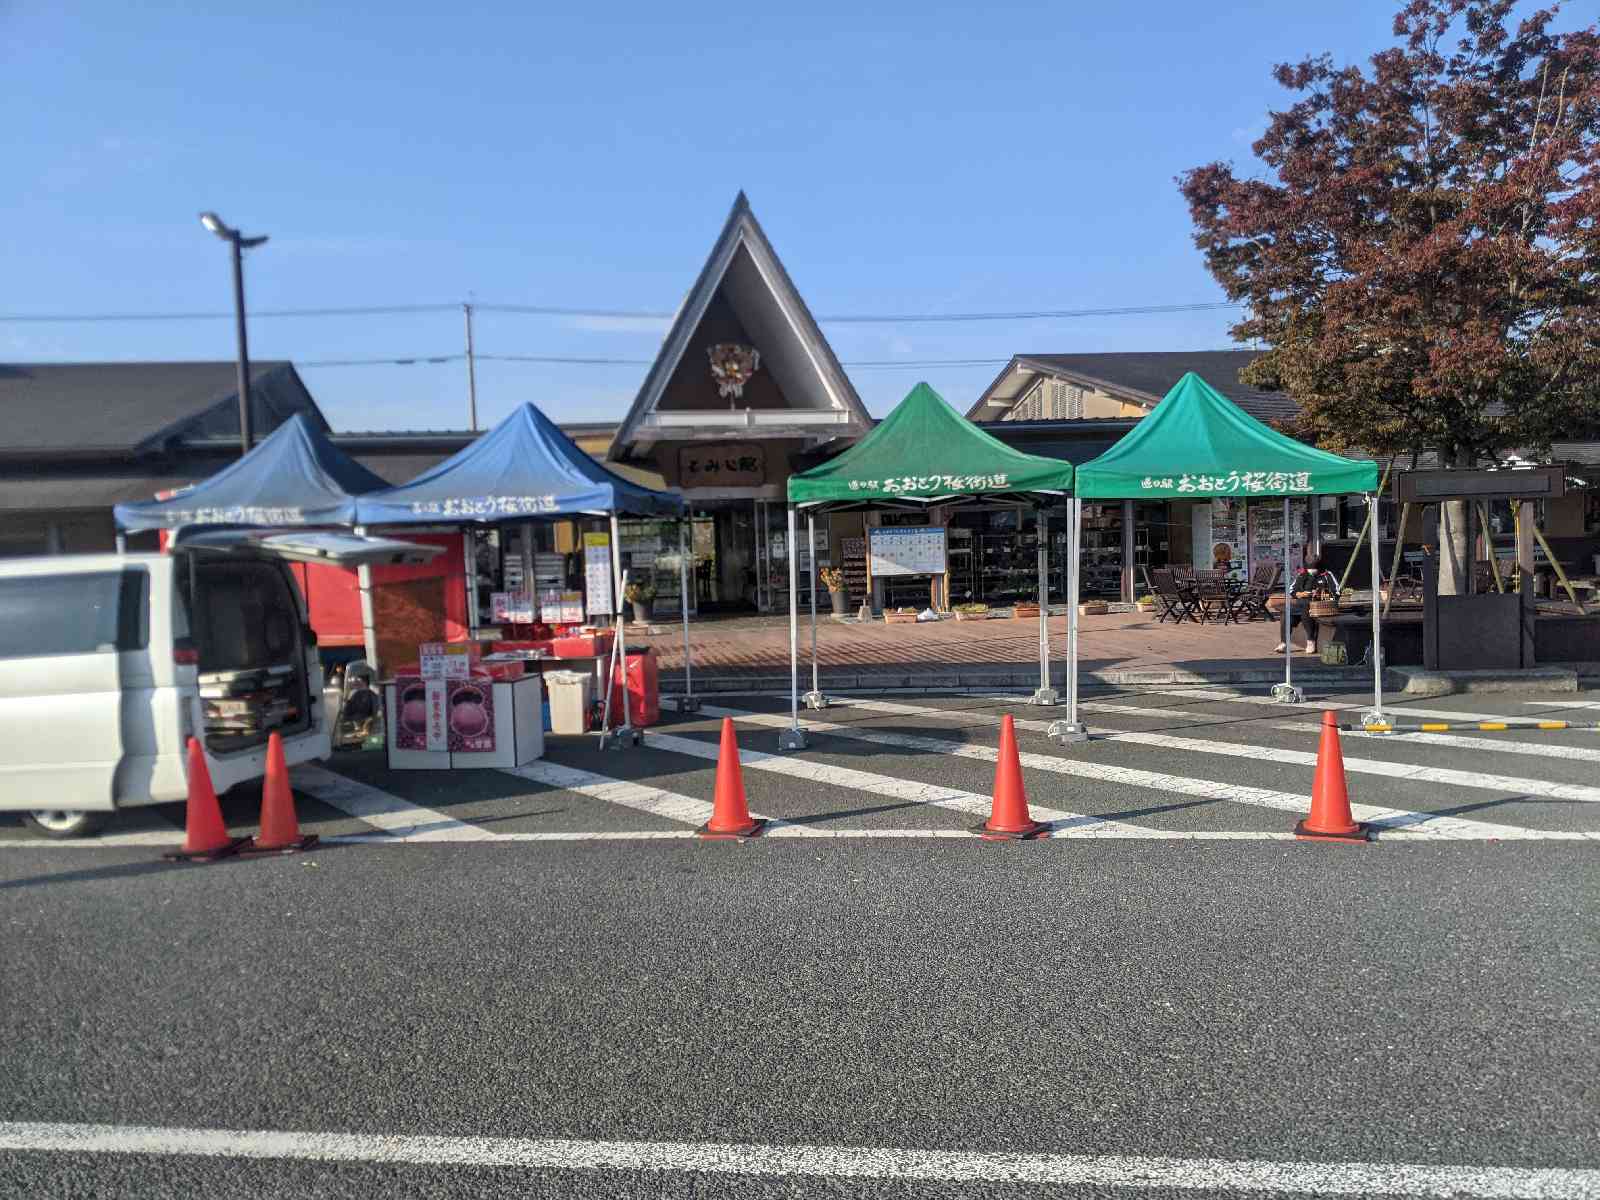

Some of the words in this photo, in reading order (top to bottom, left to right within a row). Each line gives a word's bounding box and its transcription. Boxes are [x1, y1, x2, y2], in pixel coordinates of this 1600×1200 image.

[882, 474, 1012, 493] おおとう桜街道
[1177, 470, 1314, 492] おおとう桜街道
